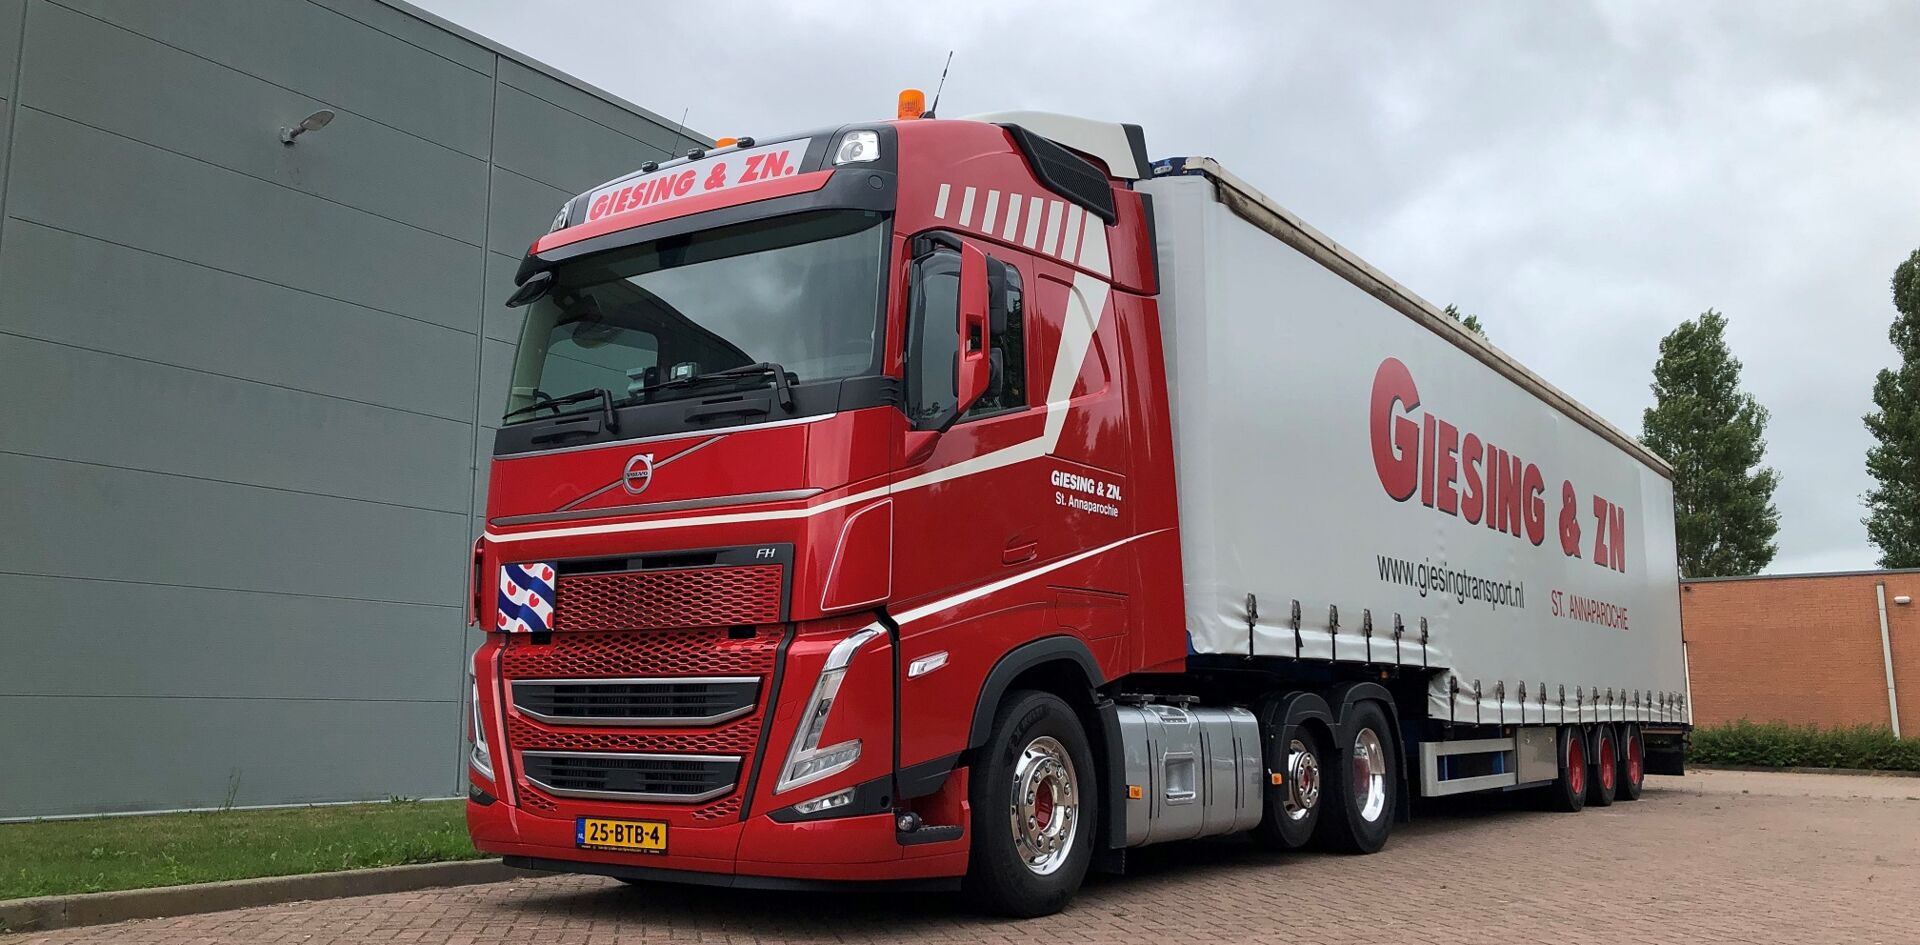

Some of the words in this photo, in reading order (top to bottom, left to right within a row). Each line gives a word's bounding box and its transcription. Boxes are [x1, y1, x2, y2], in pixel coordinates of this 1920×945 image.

[589, 169, 696, 220] GIESING
[703, 162, 727, 190] &
[738, 150, 794, 184] ZN.
[1370, 356, 1545, 546] GIESING
[1559, 479, 1582, 559] &
[1593, 494, 1625, 574] ZN
[1051, 470, 1095, 494] GIESING
[1097, 481, 1104, 497] &
[1106, 483, 1121, 500] ZN.
[1055, 491, 1066, 506] St.
[1068, 494, 1118, 517] Annaparochie
[756, 548, 776, 559] FH
[1377, 554, 1525, 611] www.giesingtransport.nl
[1551, 589, 1566, 617] ST.
[1569, 595, 1629, 631] ANNAPAROCHIE
[590, 822, 660, 845] 25-BTB-4
